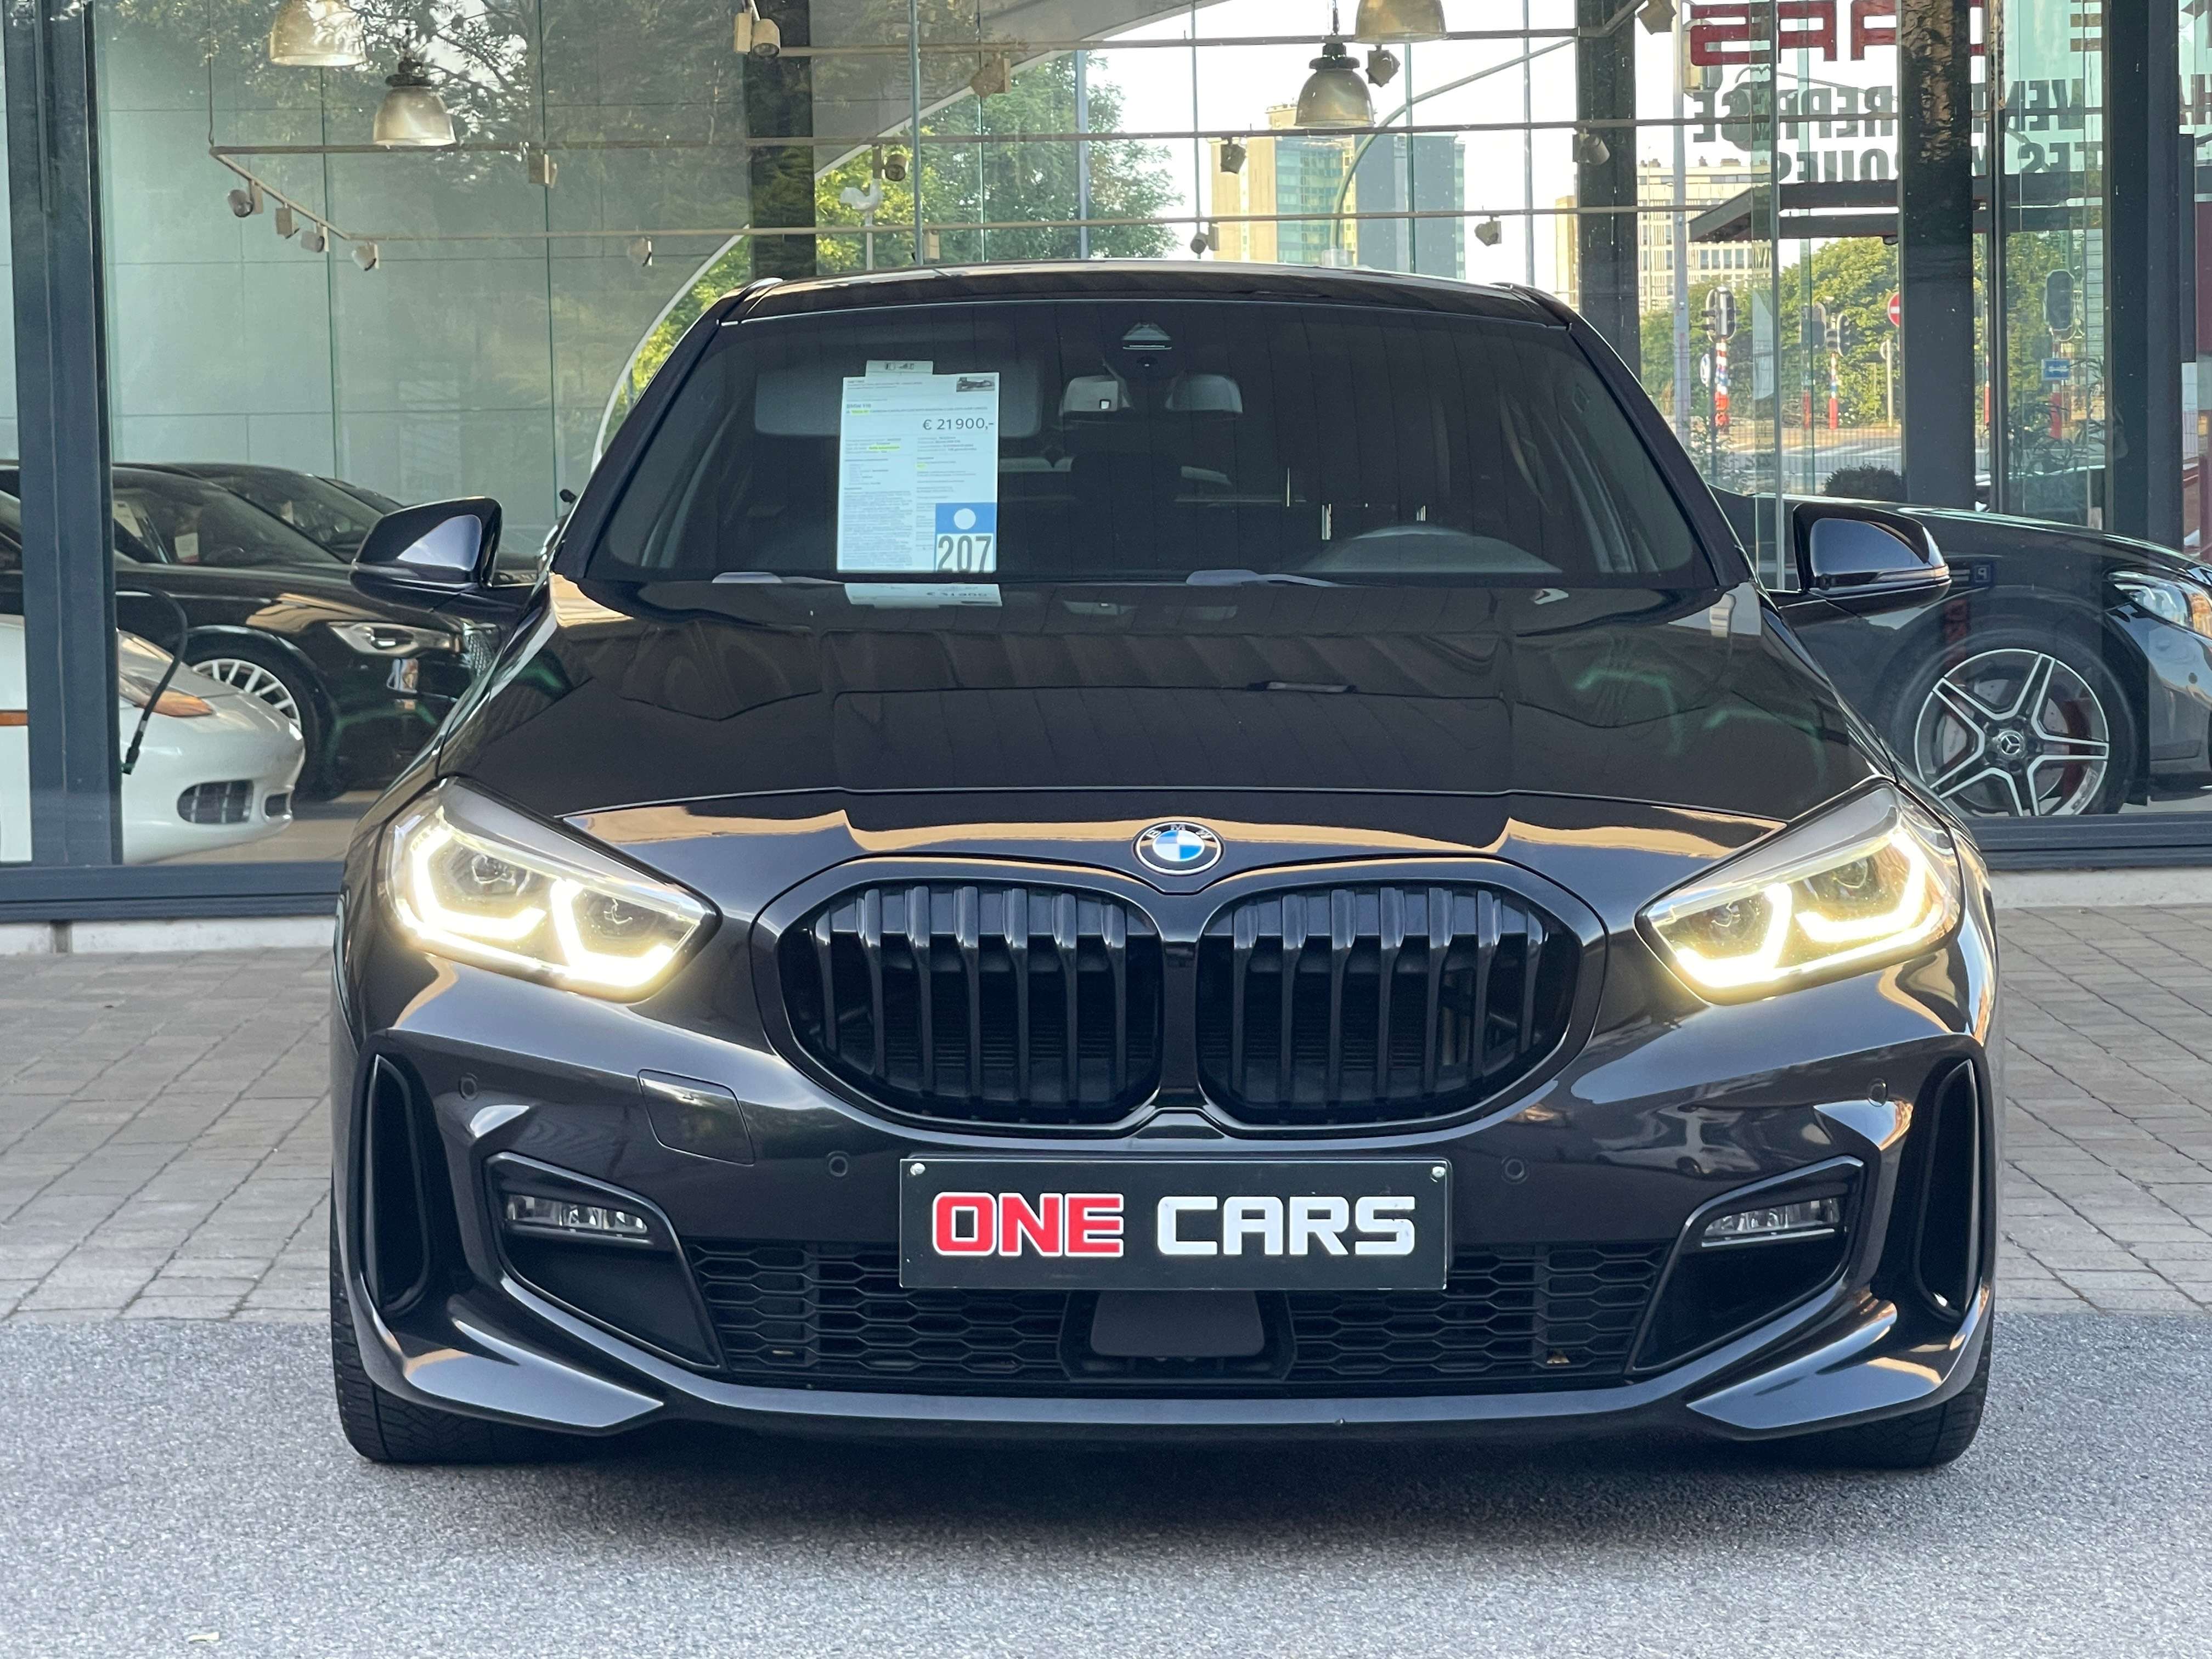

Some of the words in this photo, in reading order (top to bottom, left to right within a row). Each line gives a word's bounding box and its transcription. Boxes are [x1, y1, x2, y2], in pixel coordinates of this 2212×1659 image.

[923, 419, 932, 430] €
[937, 535, 992, 573] 207
[1146, 823, 1212, 839] BMW
[932, 1192, 1124, 1257] ONE
[1157, 1196, 1415, 1256] CARS
